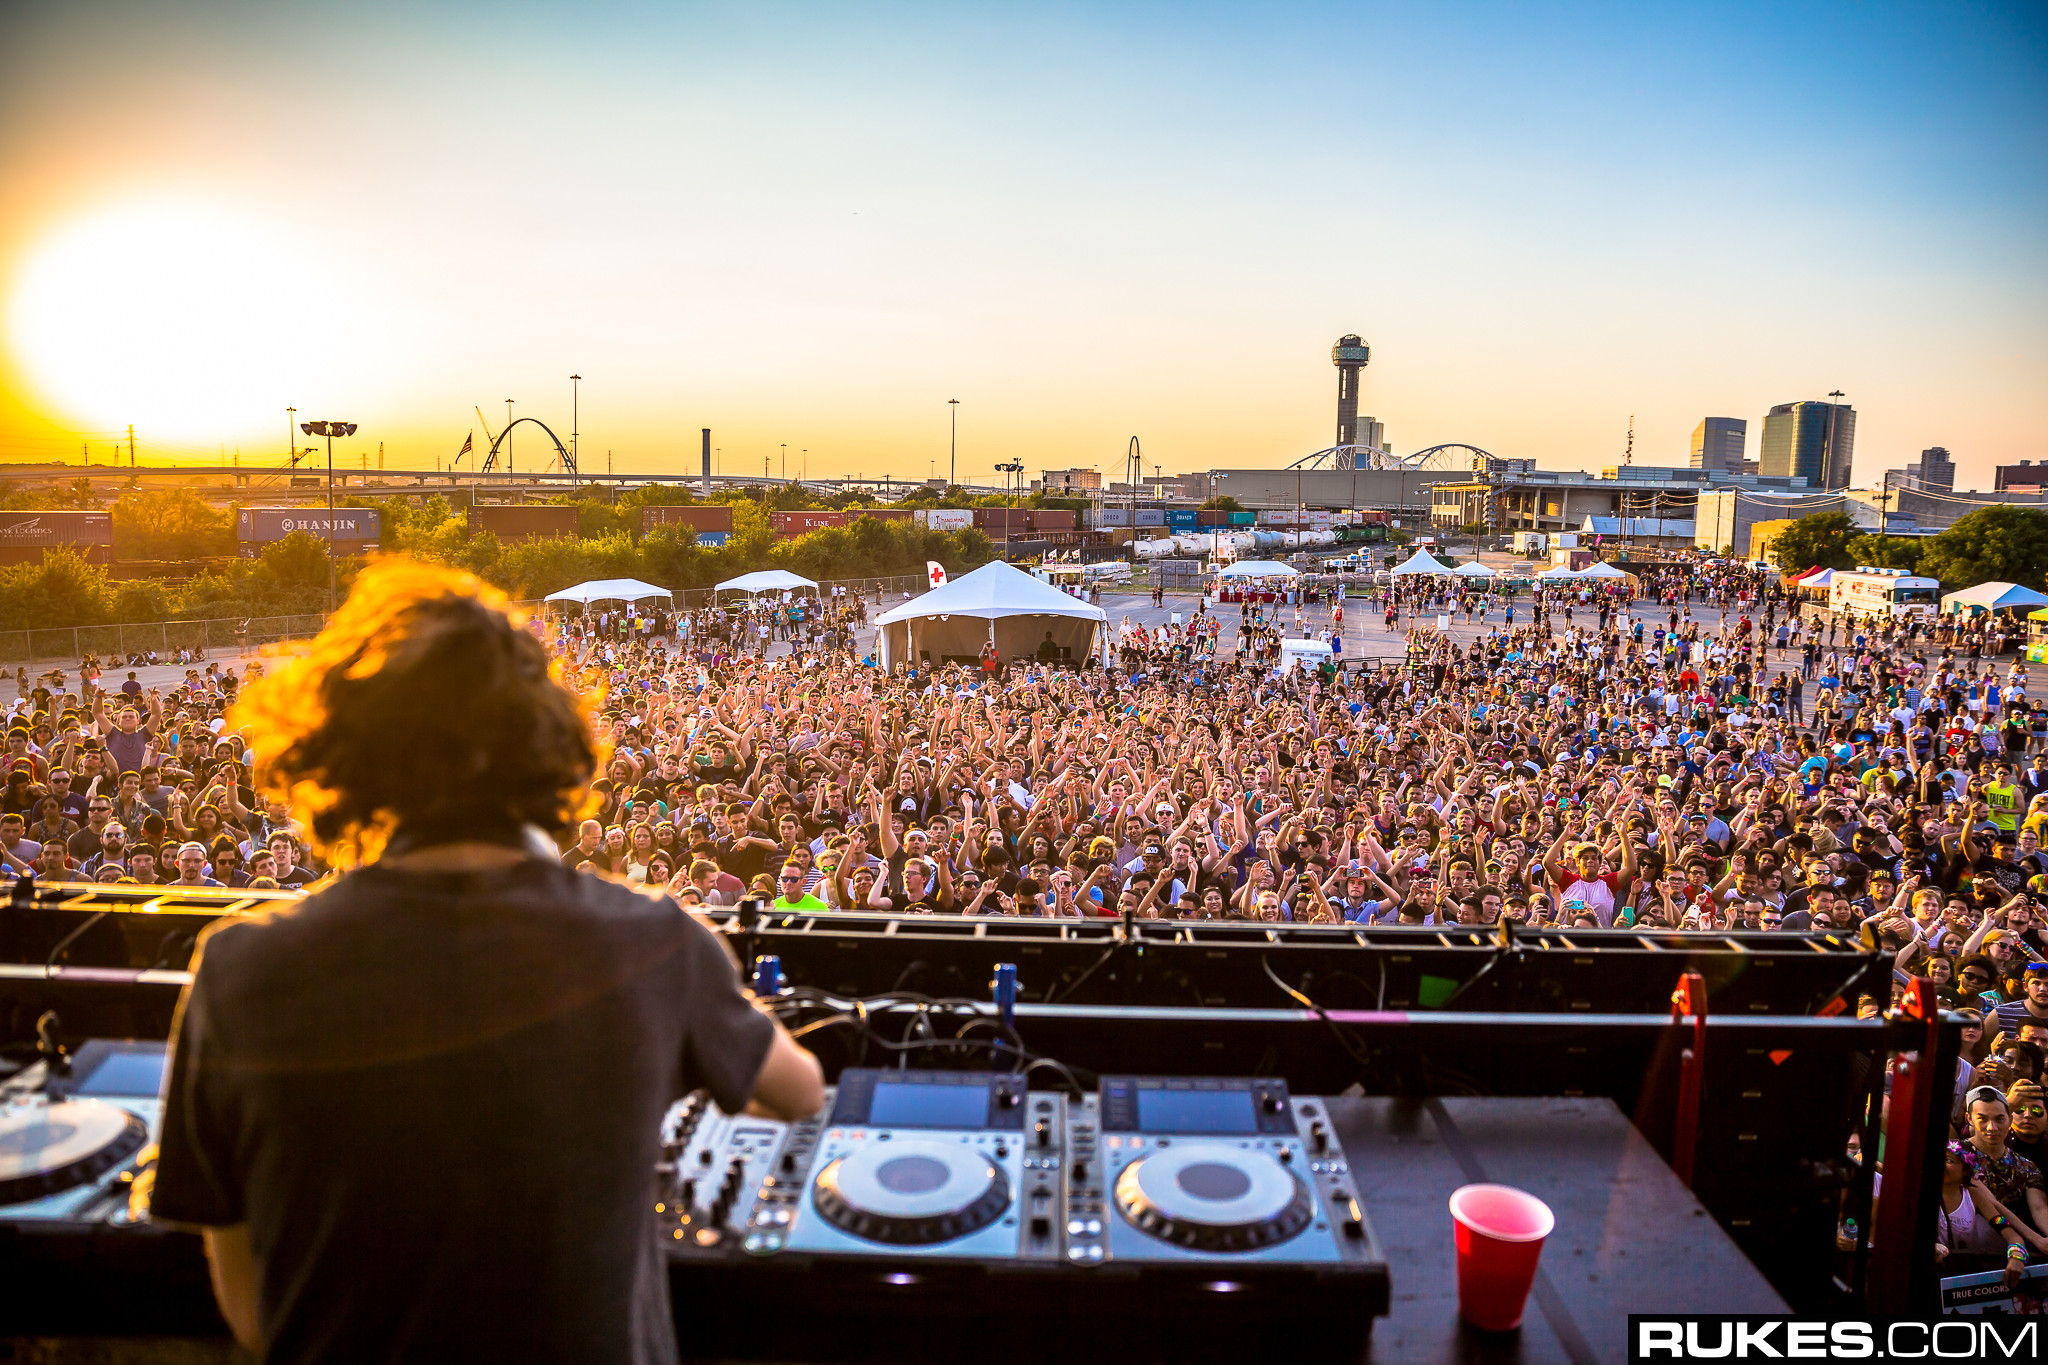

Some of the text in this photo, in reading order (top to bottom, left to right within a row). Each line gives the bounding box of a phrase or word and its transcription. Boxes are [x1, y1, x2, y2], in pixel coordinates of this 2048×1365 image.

[297, 519, 356, 531] HANJIN
[1952, 1285, 2010, 1300] TRUE COLORS
